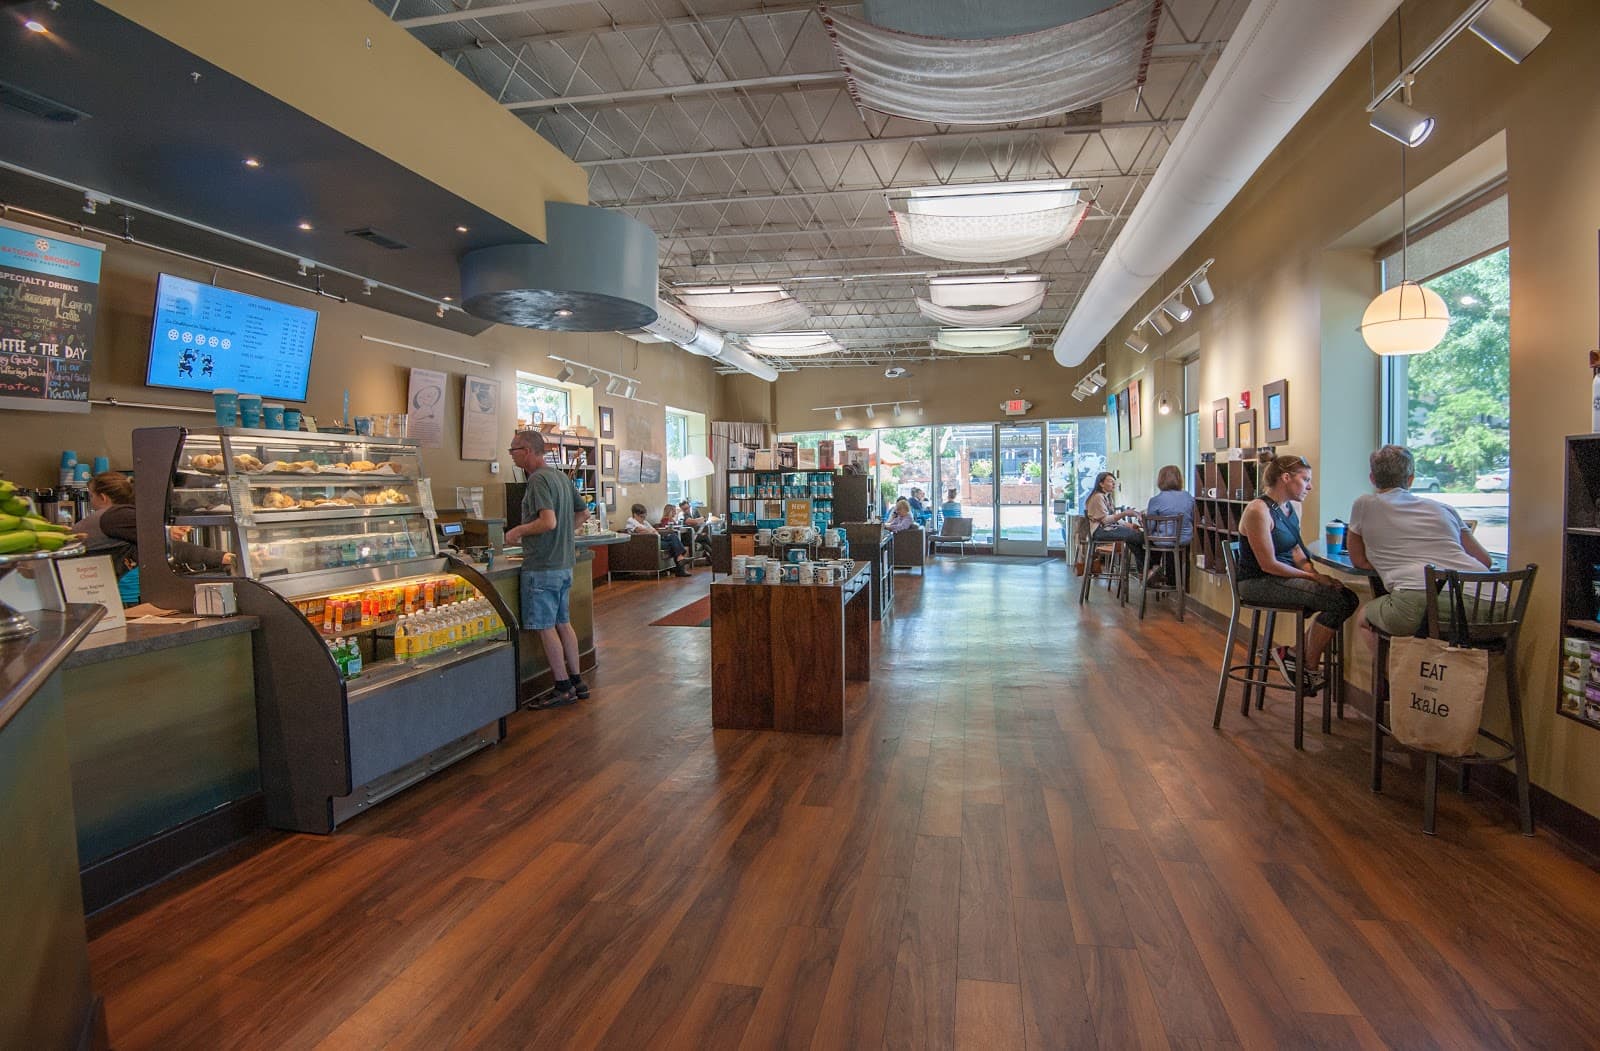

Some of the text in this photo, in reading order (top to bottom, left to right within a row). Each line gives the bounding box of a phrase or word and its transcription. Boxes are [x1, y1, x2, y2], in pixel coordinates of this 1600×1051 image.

[48, 280, 79, 293] DRINKS
[0, 338, 26, 353] FFEE
[40, 342, 60, 357] THE
[65, 345, 87, 360] DAY
[1420, 661, 1448, 681] EAT
[1409, 692, 1450, 718] kale
